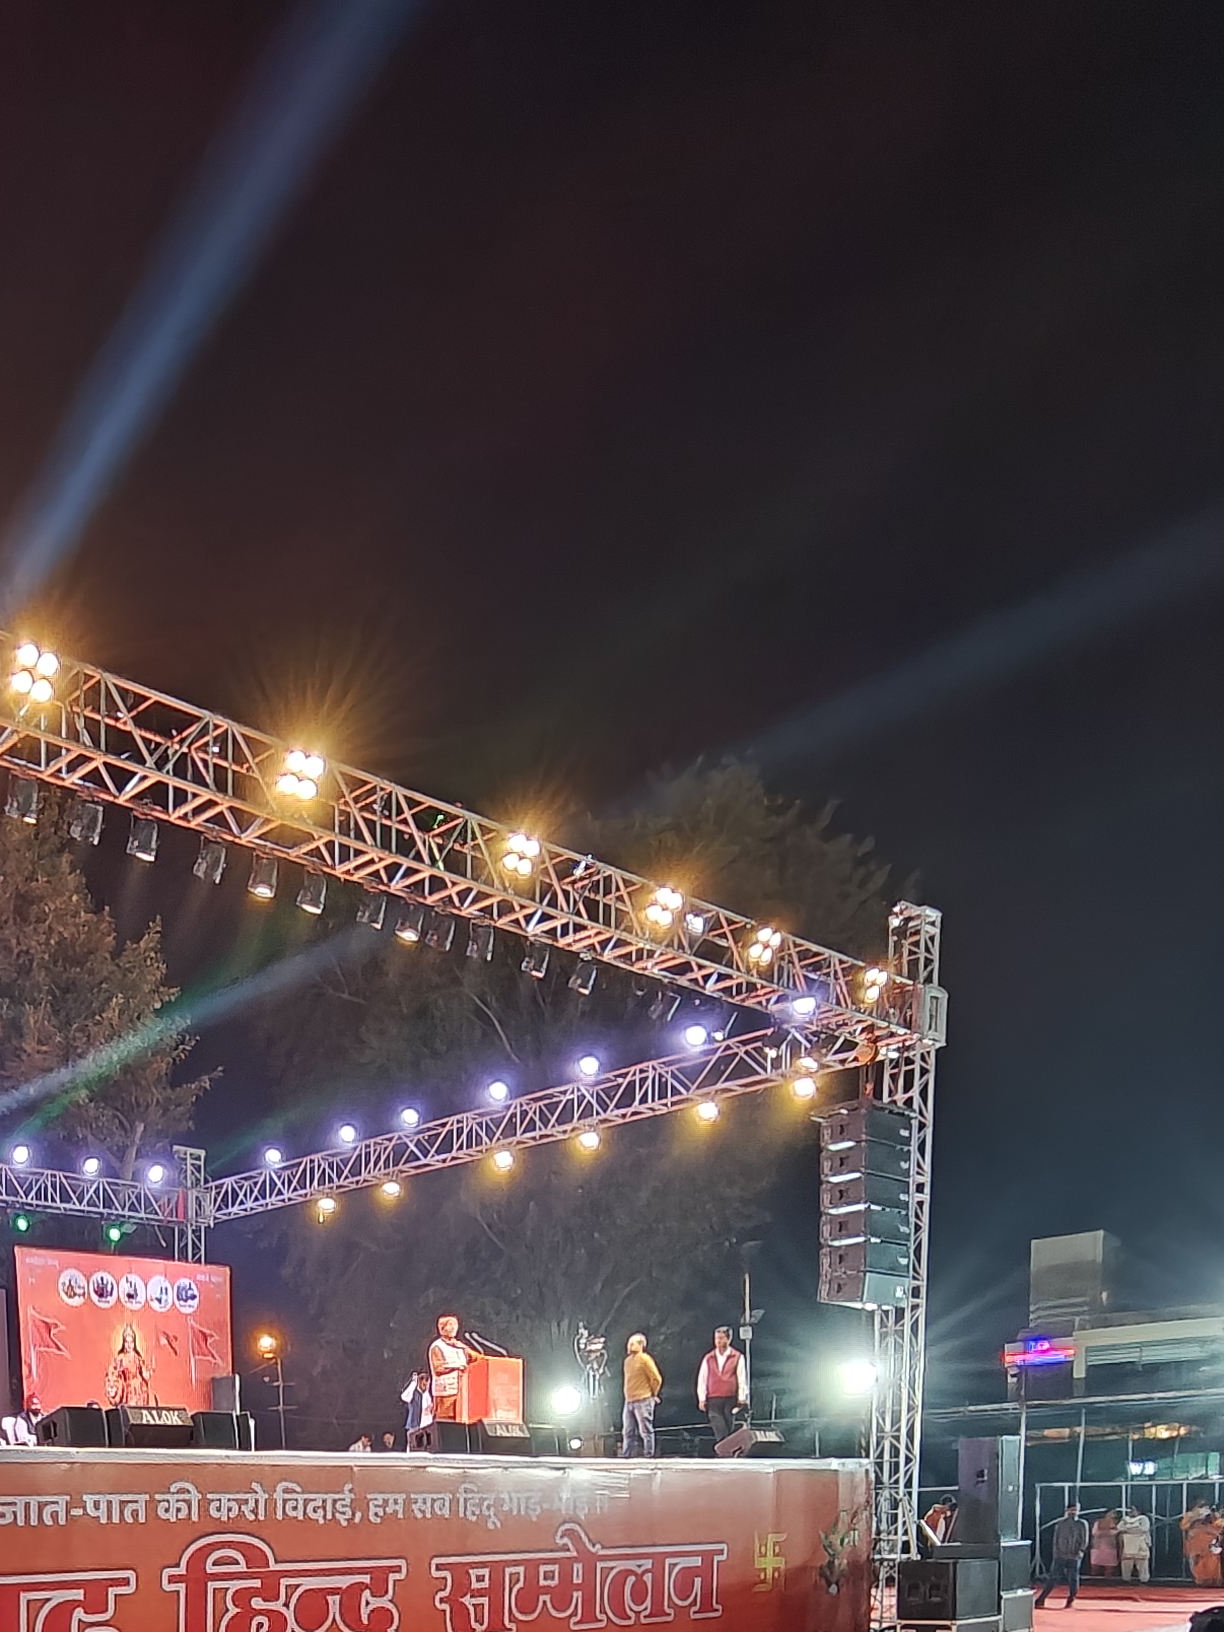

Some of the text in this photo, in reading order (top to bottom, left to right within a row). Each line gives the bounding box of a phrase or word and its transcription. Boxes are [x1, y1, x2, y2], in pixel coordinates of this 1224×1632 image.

[141, 1409, 185, 1424] ALOK
[154, 1481, 202, 1523] की
[206, 1481, 268, 1522] करो
[366, 1492, 406, 1523] हम
